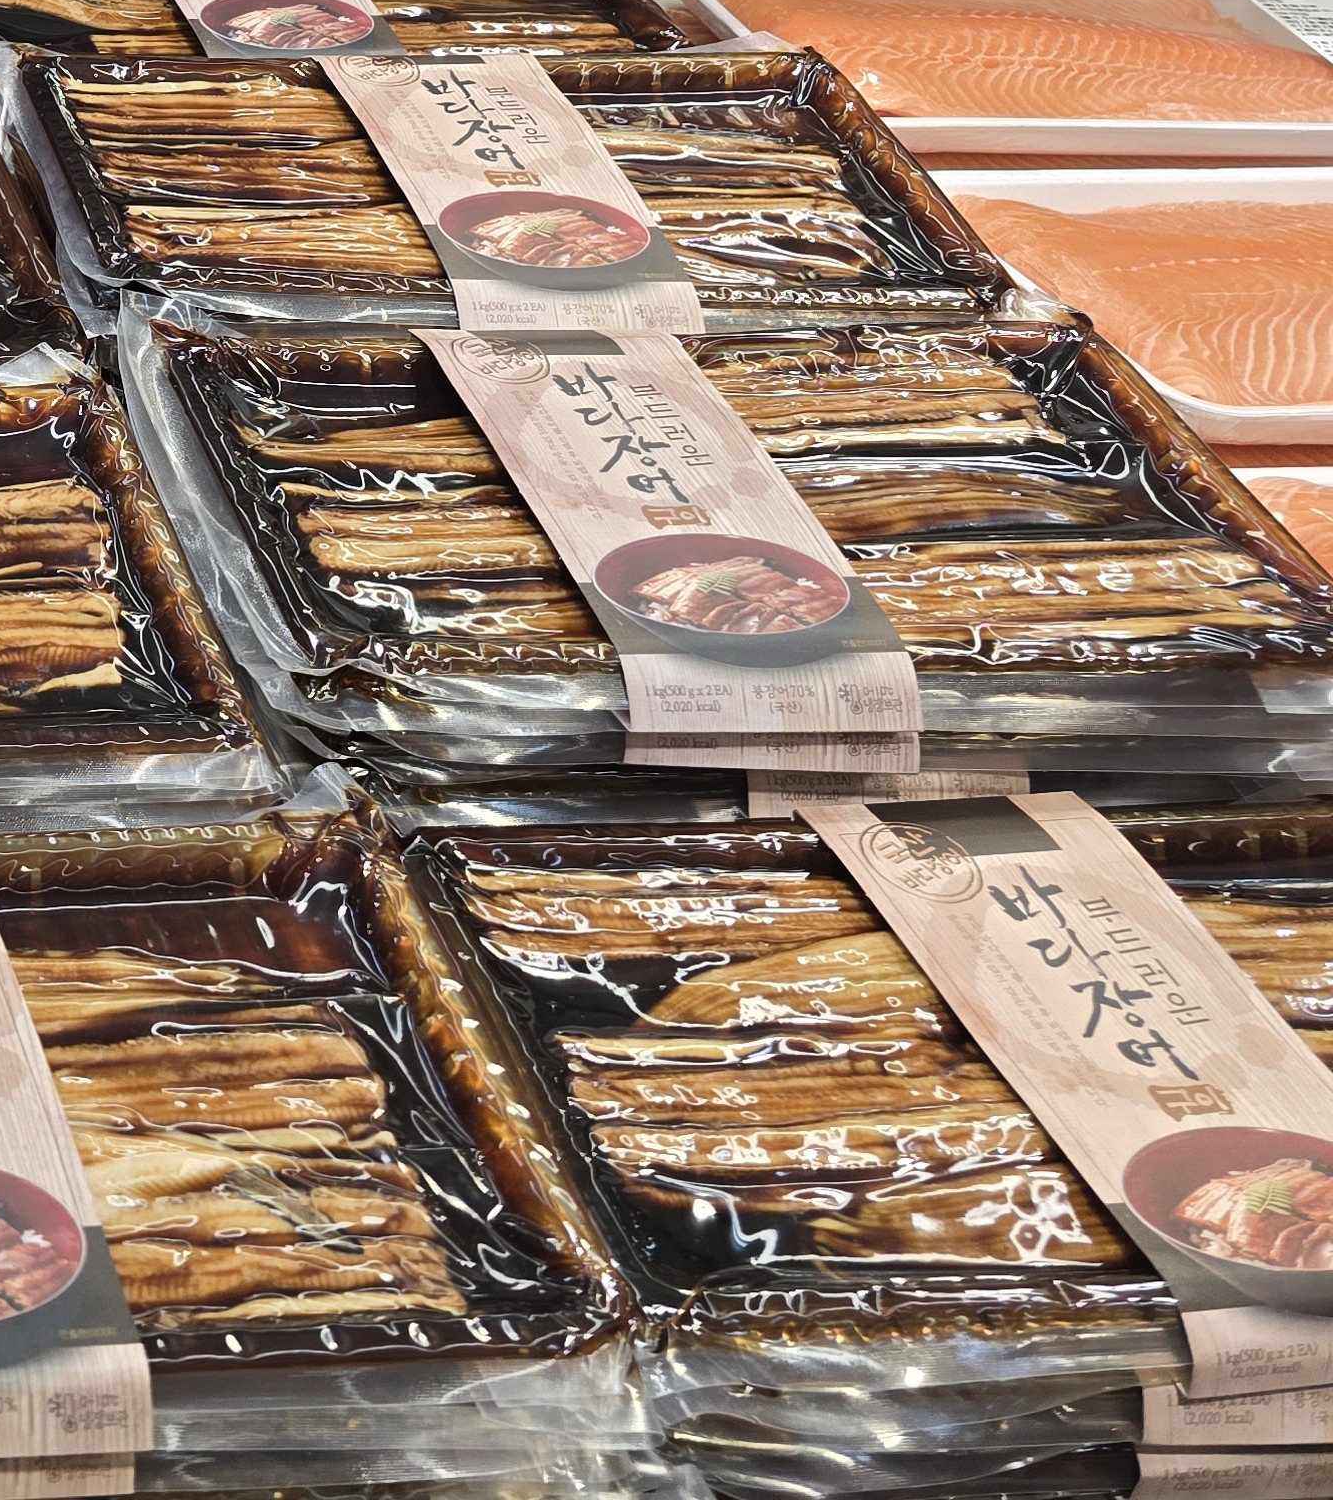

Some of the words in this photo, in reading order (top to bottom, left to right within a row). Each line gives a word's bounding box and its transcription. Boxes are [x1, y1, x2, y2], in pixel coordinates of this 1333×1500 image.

[420, 69, 522, 170] 바다장어
[553, 361, 689, 504] 바다장어
[988, 863, 1200, 1081] 바다장어
